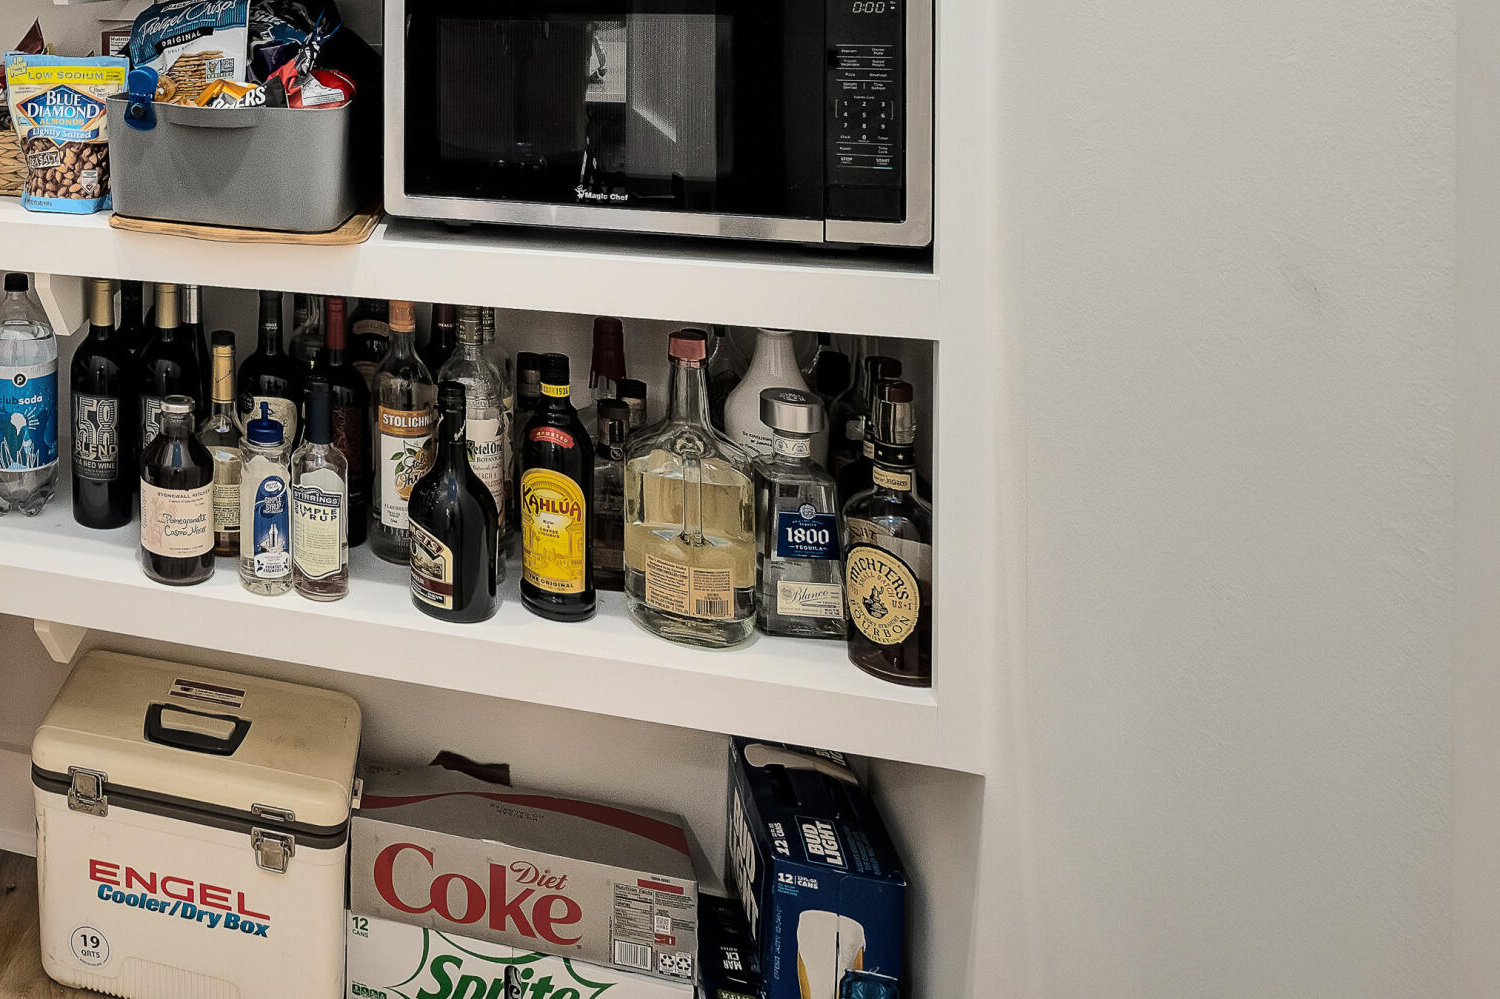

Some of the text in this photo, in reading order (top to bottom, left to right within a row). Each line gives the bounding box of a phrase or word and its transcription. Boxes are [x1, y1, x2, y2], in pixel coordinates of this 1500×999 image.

[852, 2, 885, 14] 0:00
[138, 7, 186, 45] Pretzel
[162, 30, 202, 48] ORIGINAL
[28, 71, 54, 80] LOW
[56, 71, 104, 80] SODIUM
[46, 90, 82, 106] BLUE
[27, 103, 100, 119] DIAMOND
[40, 118, 85, 126] ALMONDS
[32, 128, 92, 141] Lightly Salted
[38, 154, 58, 166] SALT
[584, 192, 608, 200] Magic
[382, 414, 432, 428] STOLICHN
[76, 438, 118, 455] BLEND
[84, 461, 97, 469] RED
[294, 491, 338, 505] STIRRINGS
[522, 483, 582, 523] KAHLÚA
[294, 501, 337, 515] SIMPLE
[294, 508, 337, 522] SYRUP
[163, 513, 207, 529] Pomegranate
[165, 526, 188, 536] Cosmo
[785, 527, 830, 545] 1800
[529, 573, 575, 589] THE ORIGINAL
[850, 558, 910, 601] MICHTER'S
[877, 574, 896, 598] BATCH
[792, 586, 829, 602] Blanco
[802, 822, 825, 856] BUD
[816, 820, 844, 866] LIGHT
[776, 840, 790, 856] 12
[510, 861, 569, 892] Diet
[778, 872, 795, 885] 12
[89, 858, 271, 921] ENGEL
[616, 884, 638, 894] Nutrition
[798, 881, 819, 890] CANS
[374, 843, 583, 946] Coke
[97, 884, 271, 938] Cooler/Dry Box
[352, 916, 369, 932] 12
[80, 934, 101, 949] 19
[352, 929, 370, 939] CANS
[80, 948, 101, 959] QRTS
[416, 954, 581, 999] Sprite
